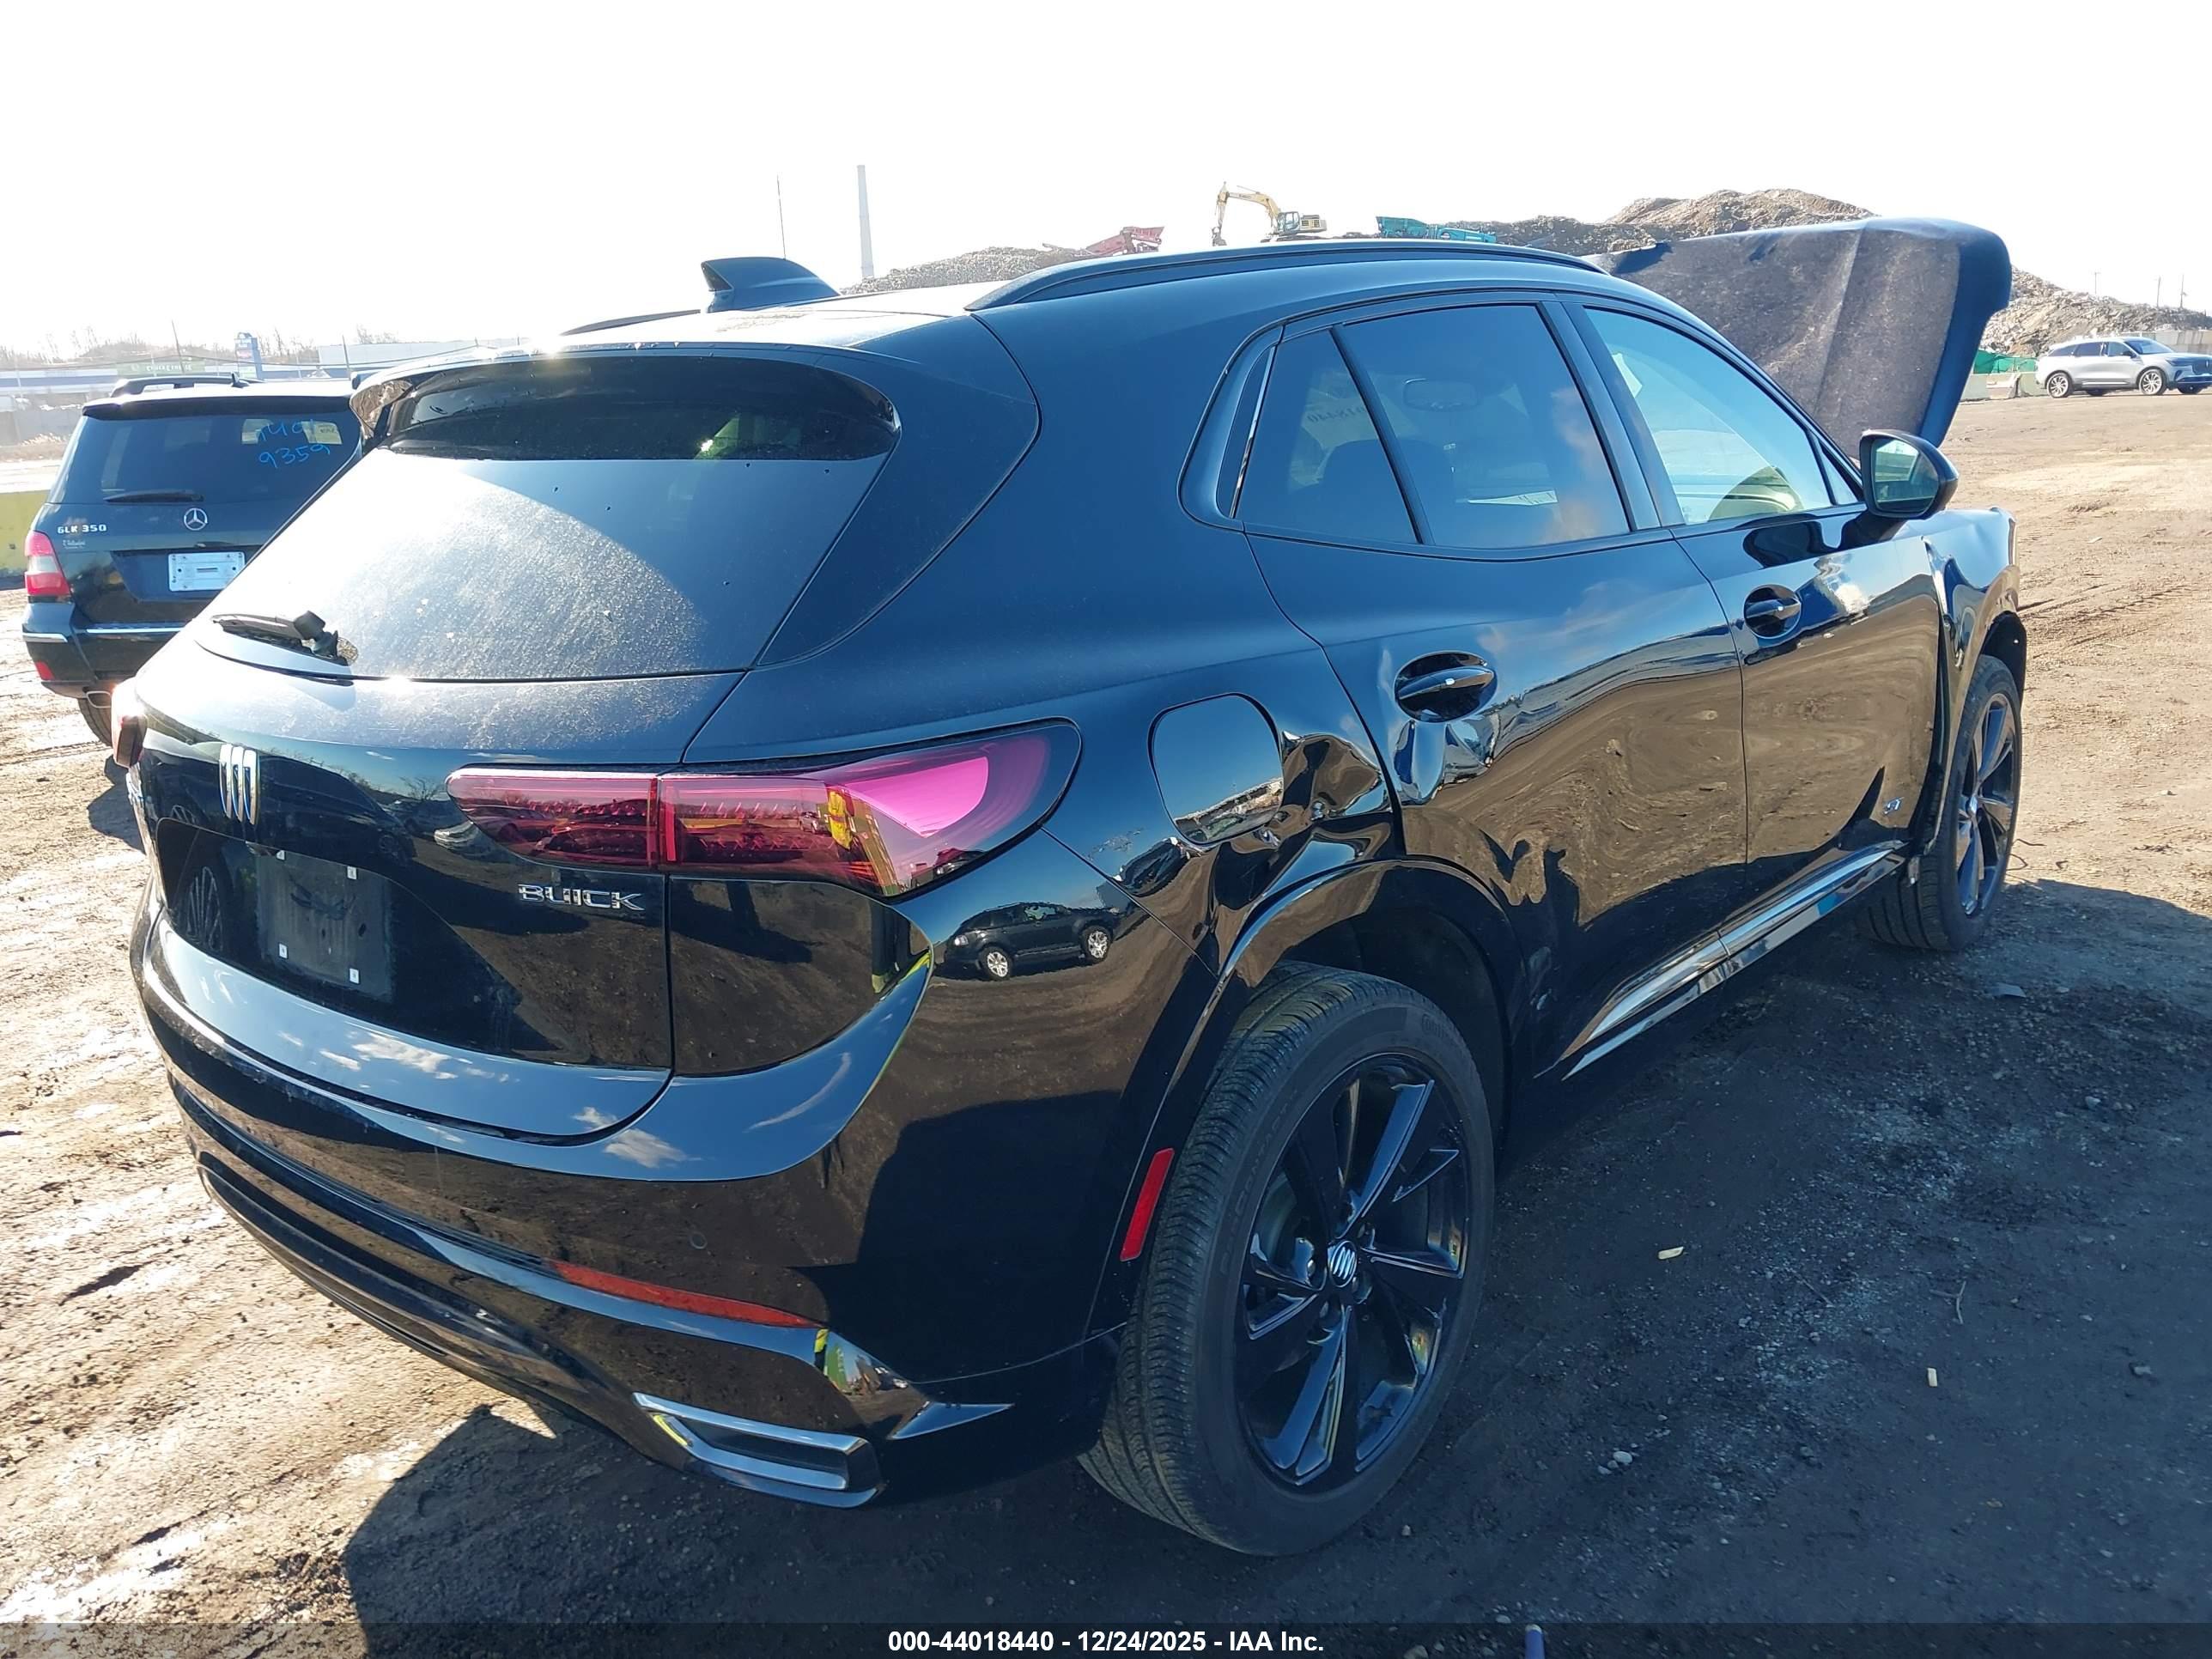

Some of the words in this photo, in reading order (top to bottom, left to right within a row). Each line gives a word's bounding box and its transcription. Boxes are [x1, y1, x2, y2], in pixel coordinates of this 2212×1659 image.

[258, 444, 331, 469] 9359
[58, 526, 78, 534] GLK
[518, 884, 645, 911] BUICK
